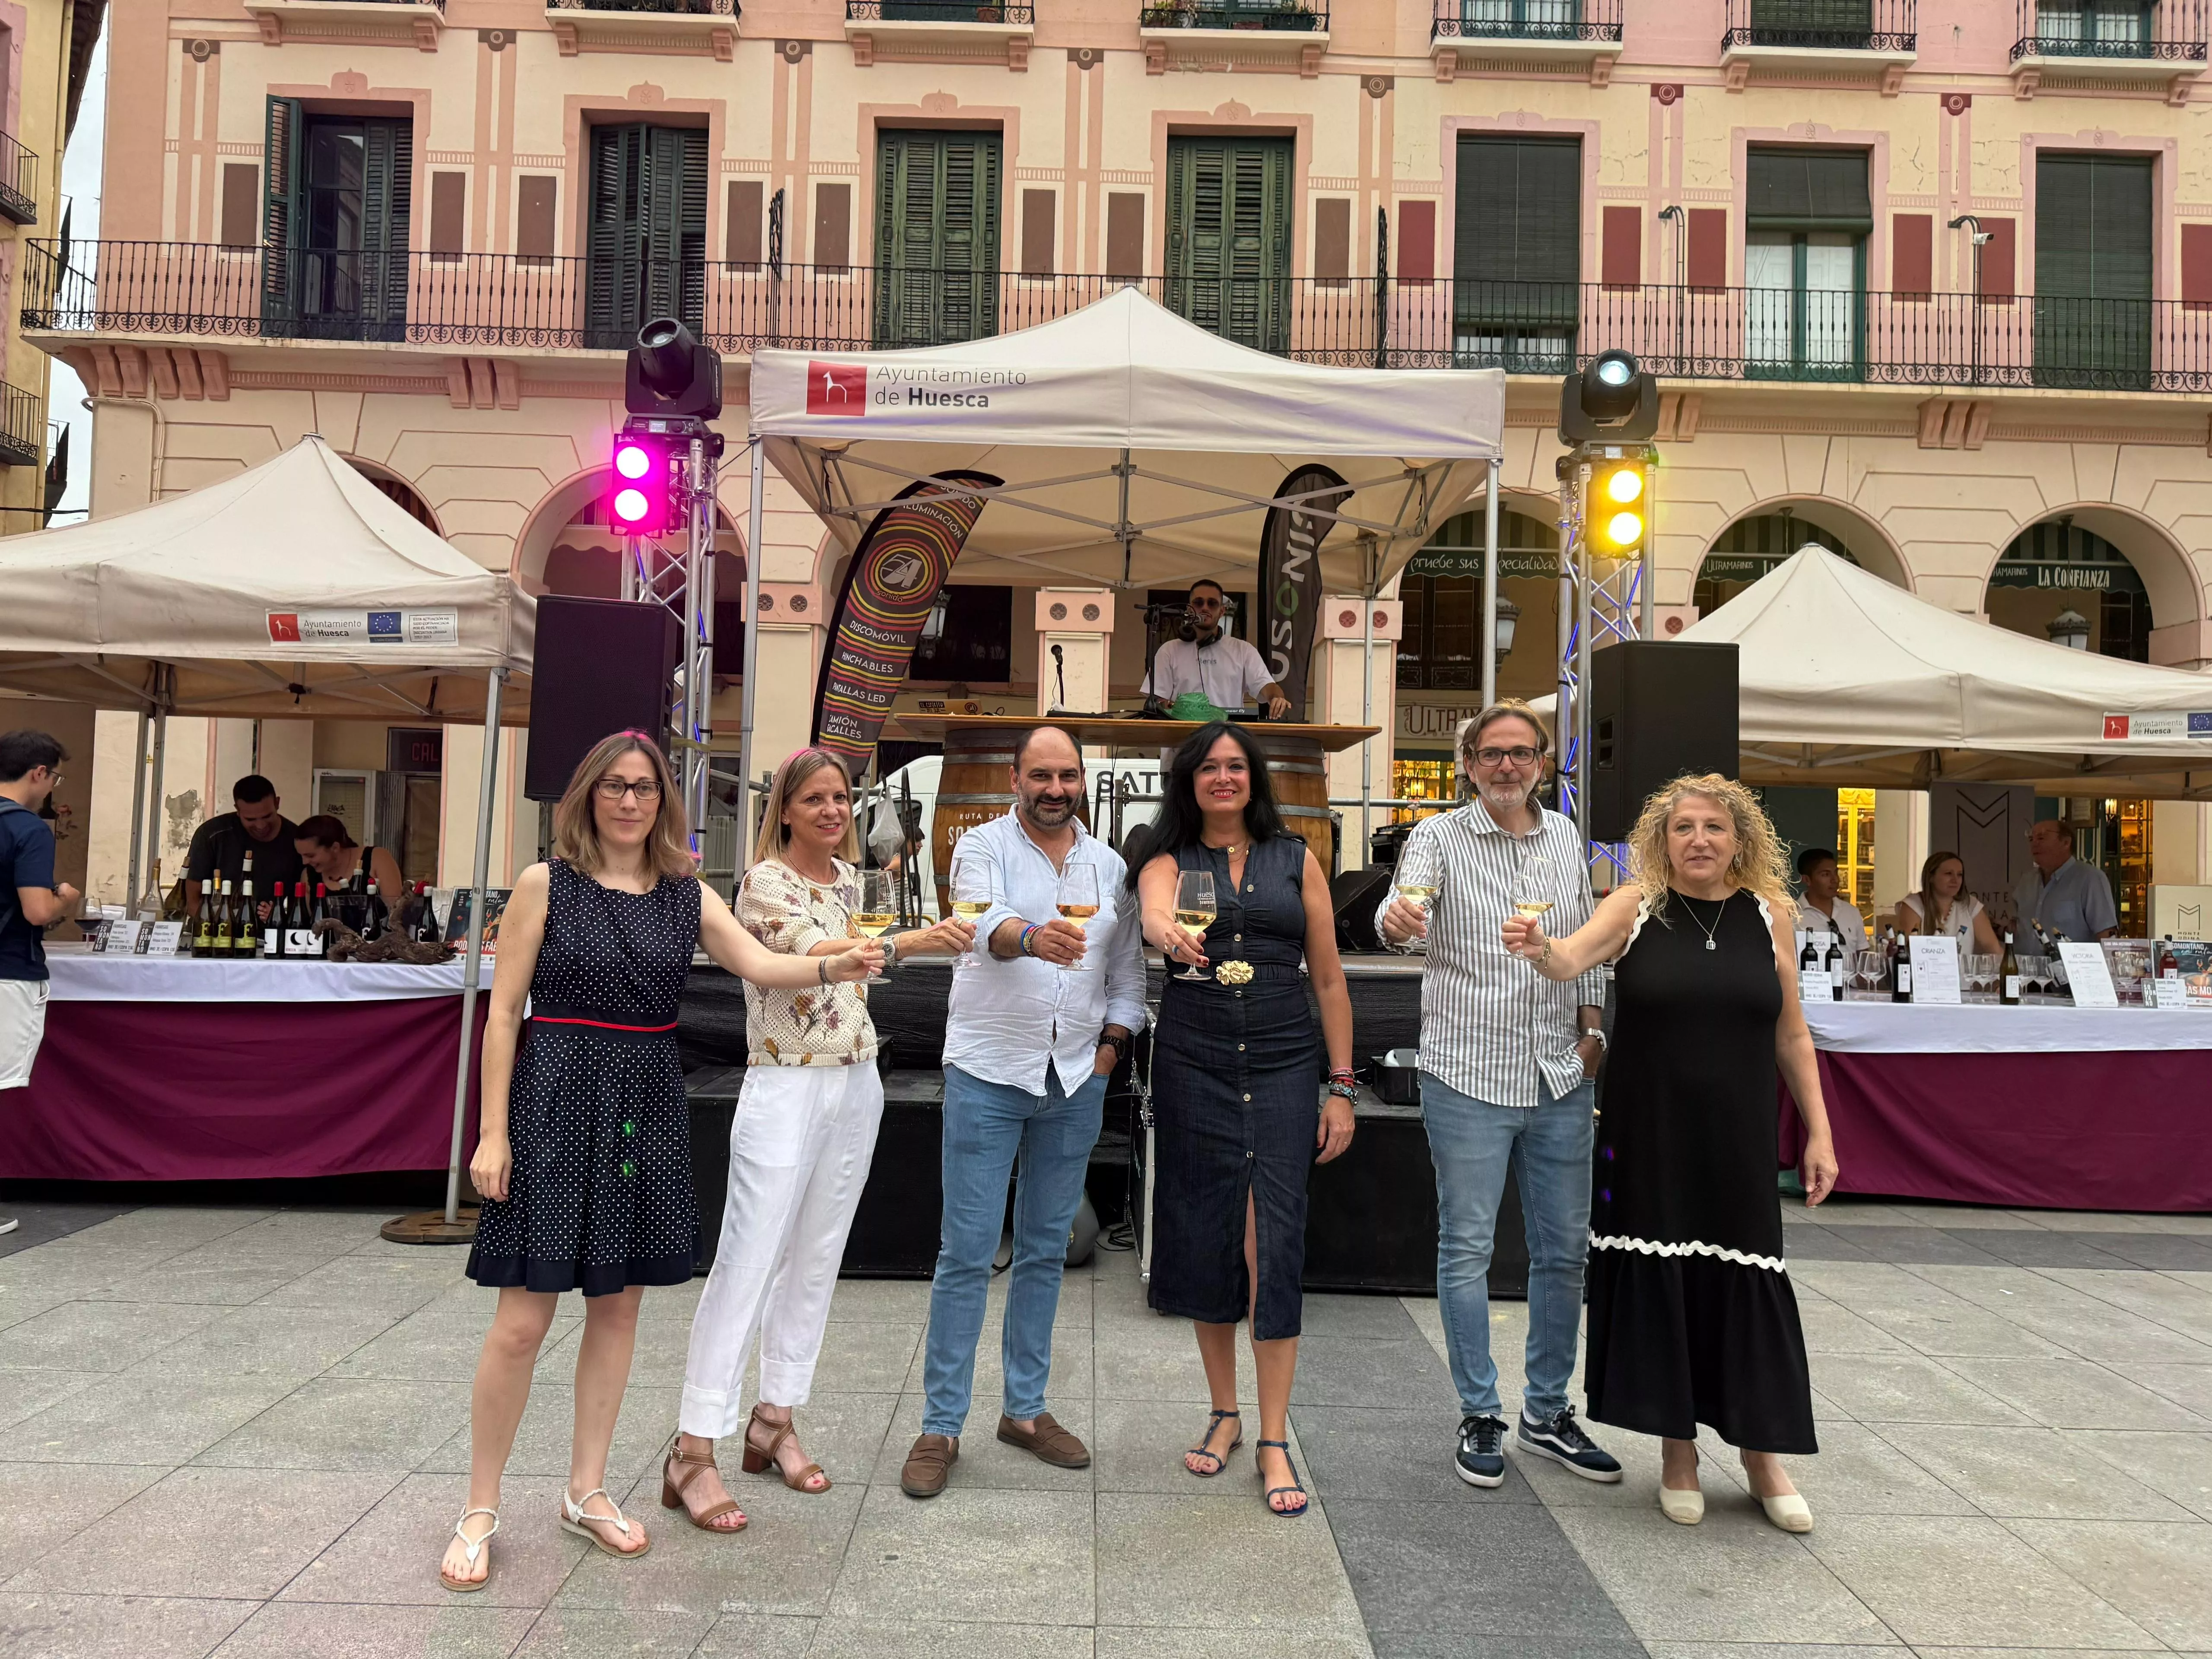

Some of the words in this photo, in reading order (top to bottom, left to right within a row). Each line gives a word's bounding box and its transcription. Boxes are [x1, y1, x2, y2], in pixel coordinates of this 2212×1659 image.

[876, 365, 1027, 386] Ayuntamiento
[875, 386, 899, 405] de
[908, 387, 989, 408] Huesca
[1410, 554, 1453, 572] pruebe
[1459, 557, 1479, 569] sus
[1497, 556, 1559, 575] pecialidad
[1707, 559, 1754, 572] ULTRAMARINOS
[1993, 566, 2028, 577] RAMARINOS
[2038, 566, 2050, 586] LA
[2054, 567, 2110, 588] CONFIANZA
[876, 589, 903, 602] sonido
[303, 620, 361, 629] Ayuntamiento
[850, 620, 906, 643] DISCOMÓVIL
[842, 652, 893, 673] HINCHABLES
[833, 682, 865, 699] PANTALLAS
[868, 693, 885, 702] LED
[829, 715, 858, 728] AMIÓN
[1410, 706, 1482, 734] ULTR
[1096, 771, 1164, 793] SAT
[1970, 892, 2009, 903] ONTE
